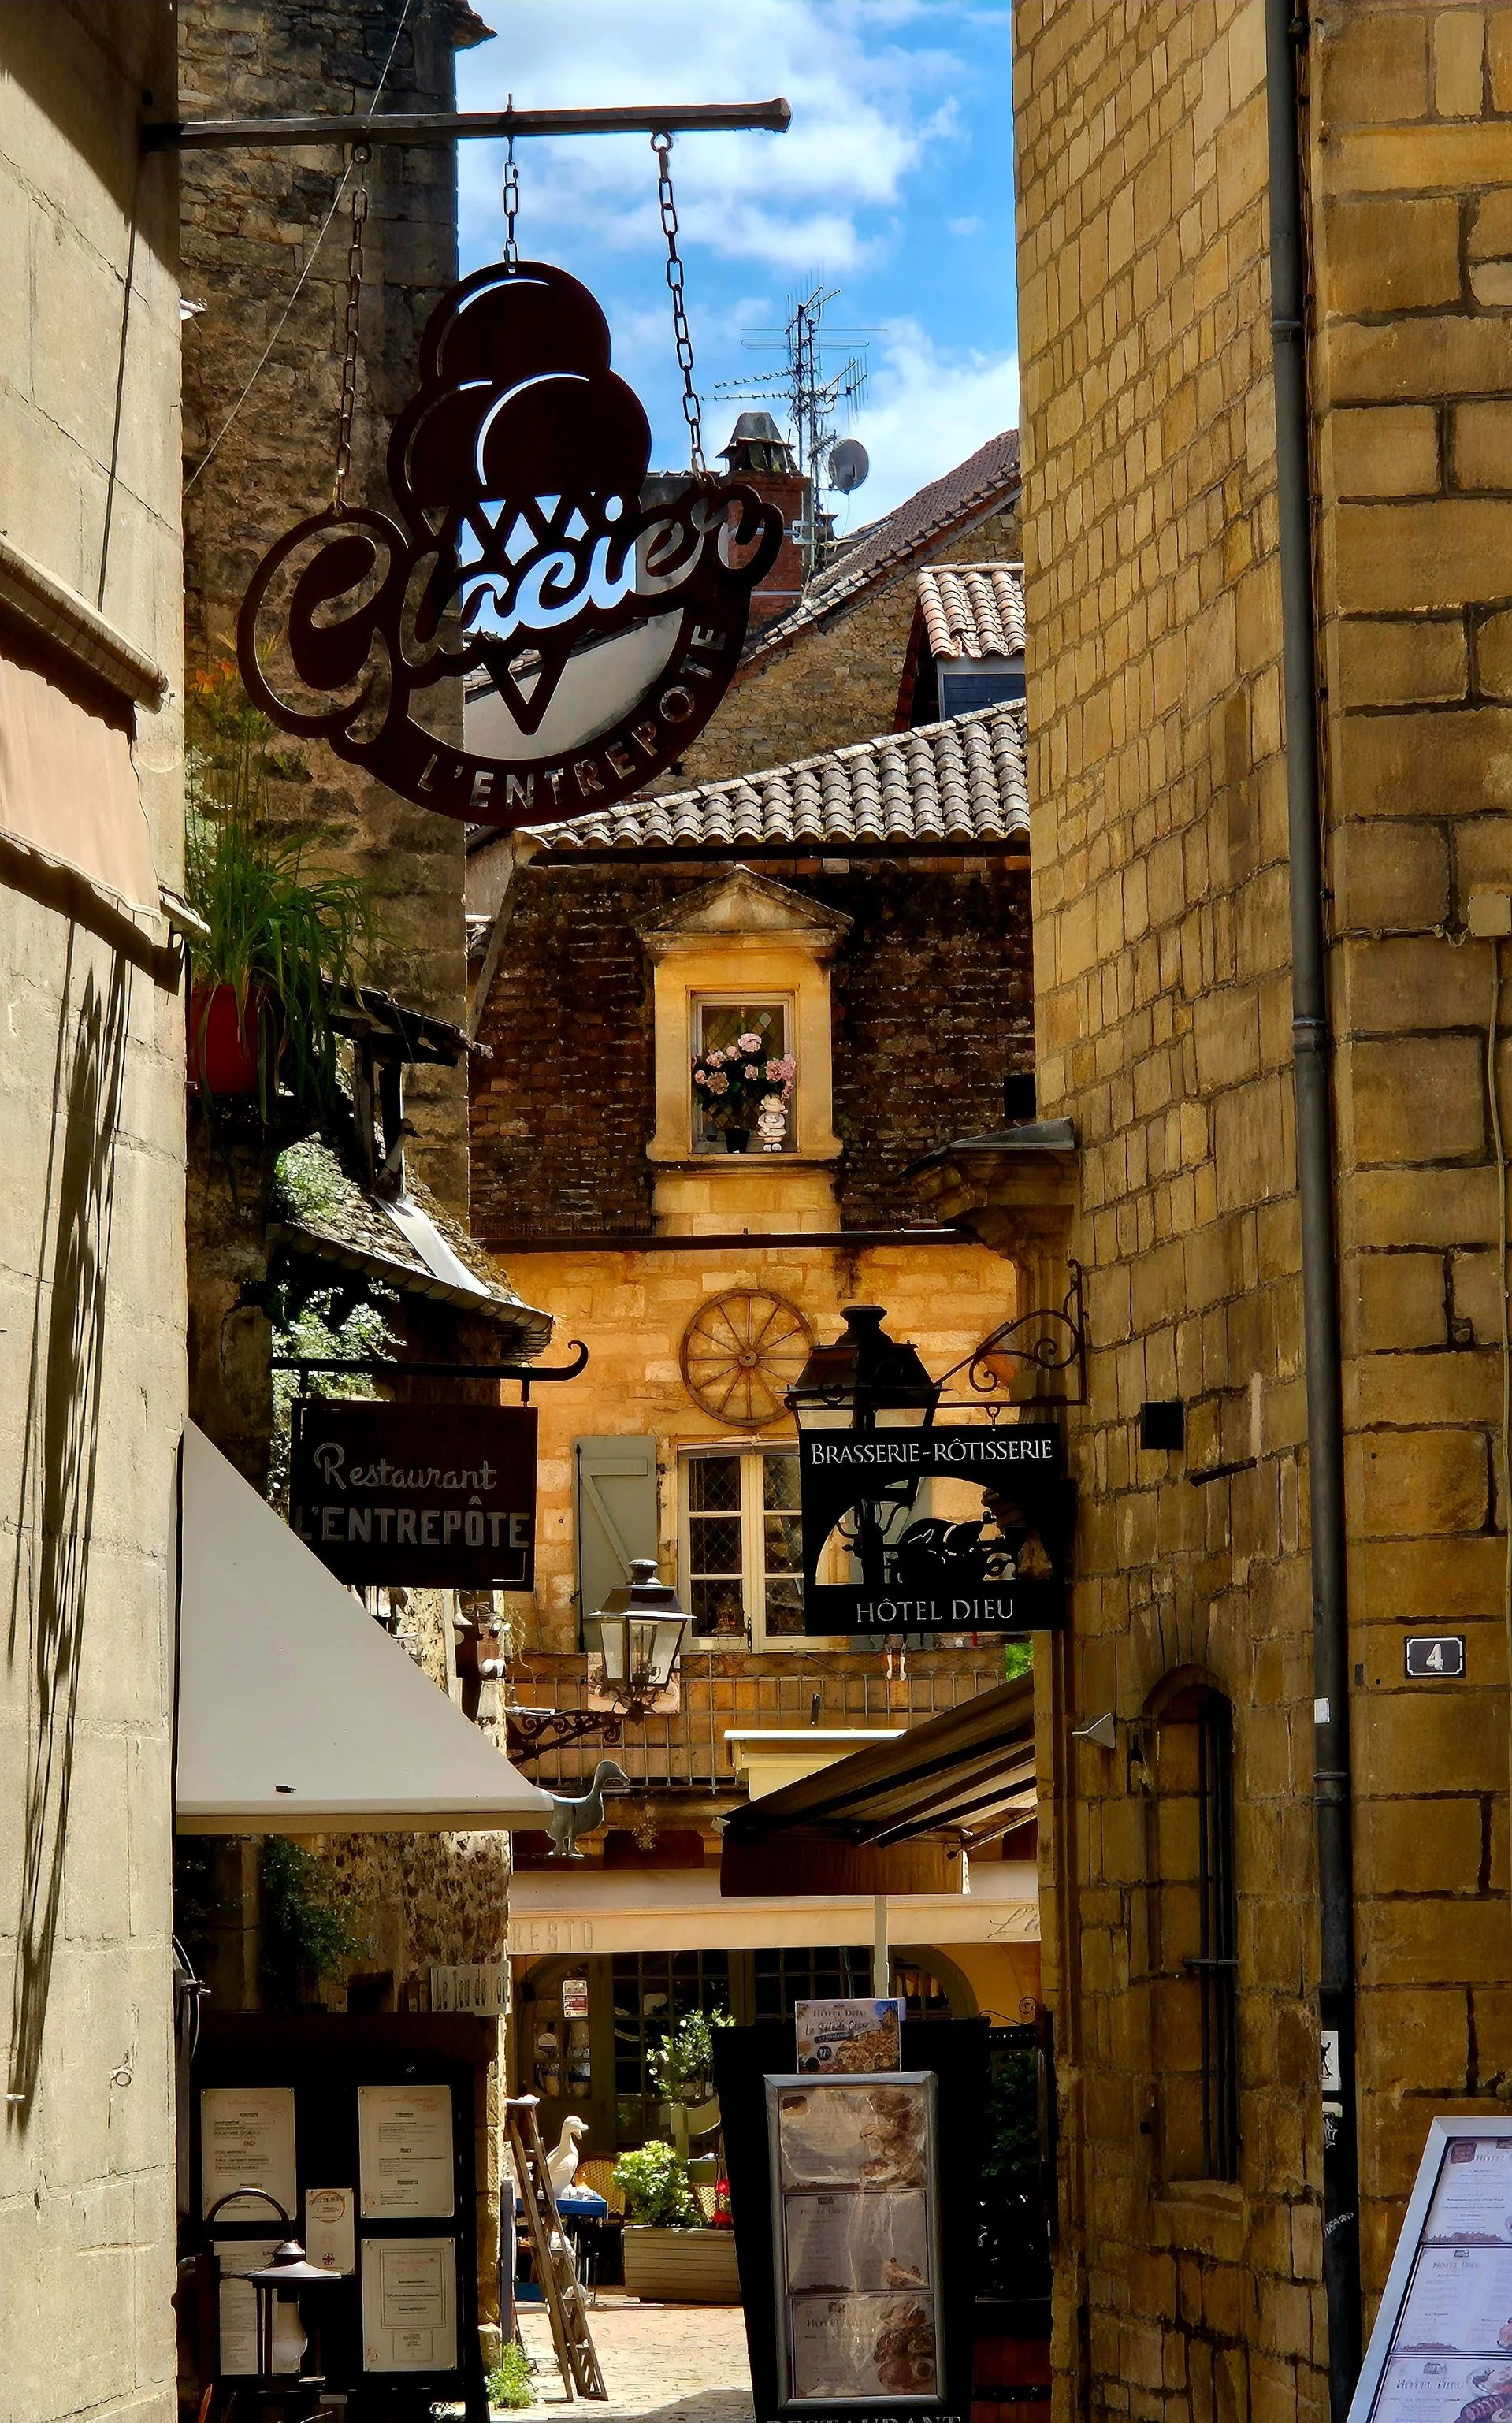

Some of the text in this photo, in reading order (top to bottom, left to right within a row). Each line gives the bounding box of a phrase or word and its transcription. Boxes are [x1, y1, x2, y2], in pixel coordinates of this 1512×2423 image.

[254, 495, 766, 745] Glacier
[416, 622, 729, 810] L'ENTREPOTE
[313, 1442, 497, 1490] Restaurant
[295, 1495, 530, 1548] L'ENTREPÔTE
[856, 1597, 1014, 1622] HÔTEL DIEU
[1425, 1643, 1444, 1670] 4
[512, 1920, 593, 1952] RESTO
